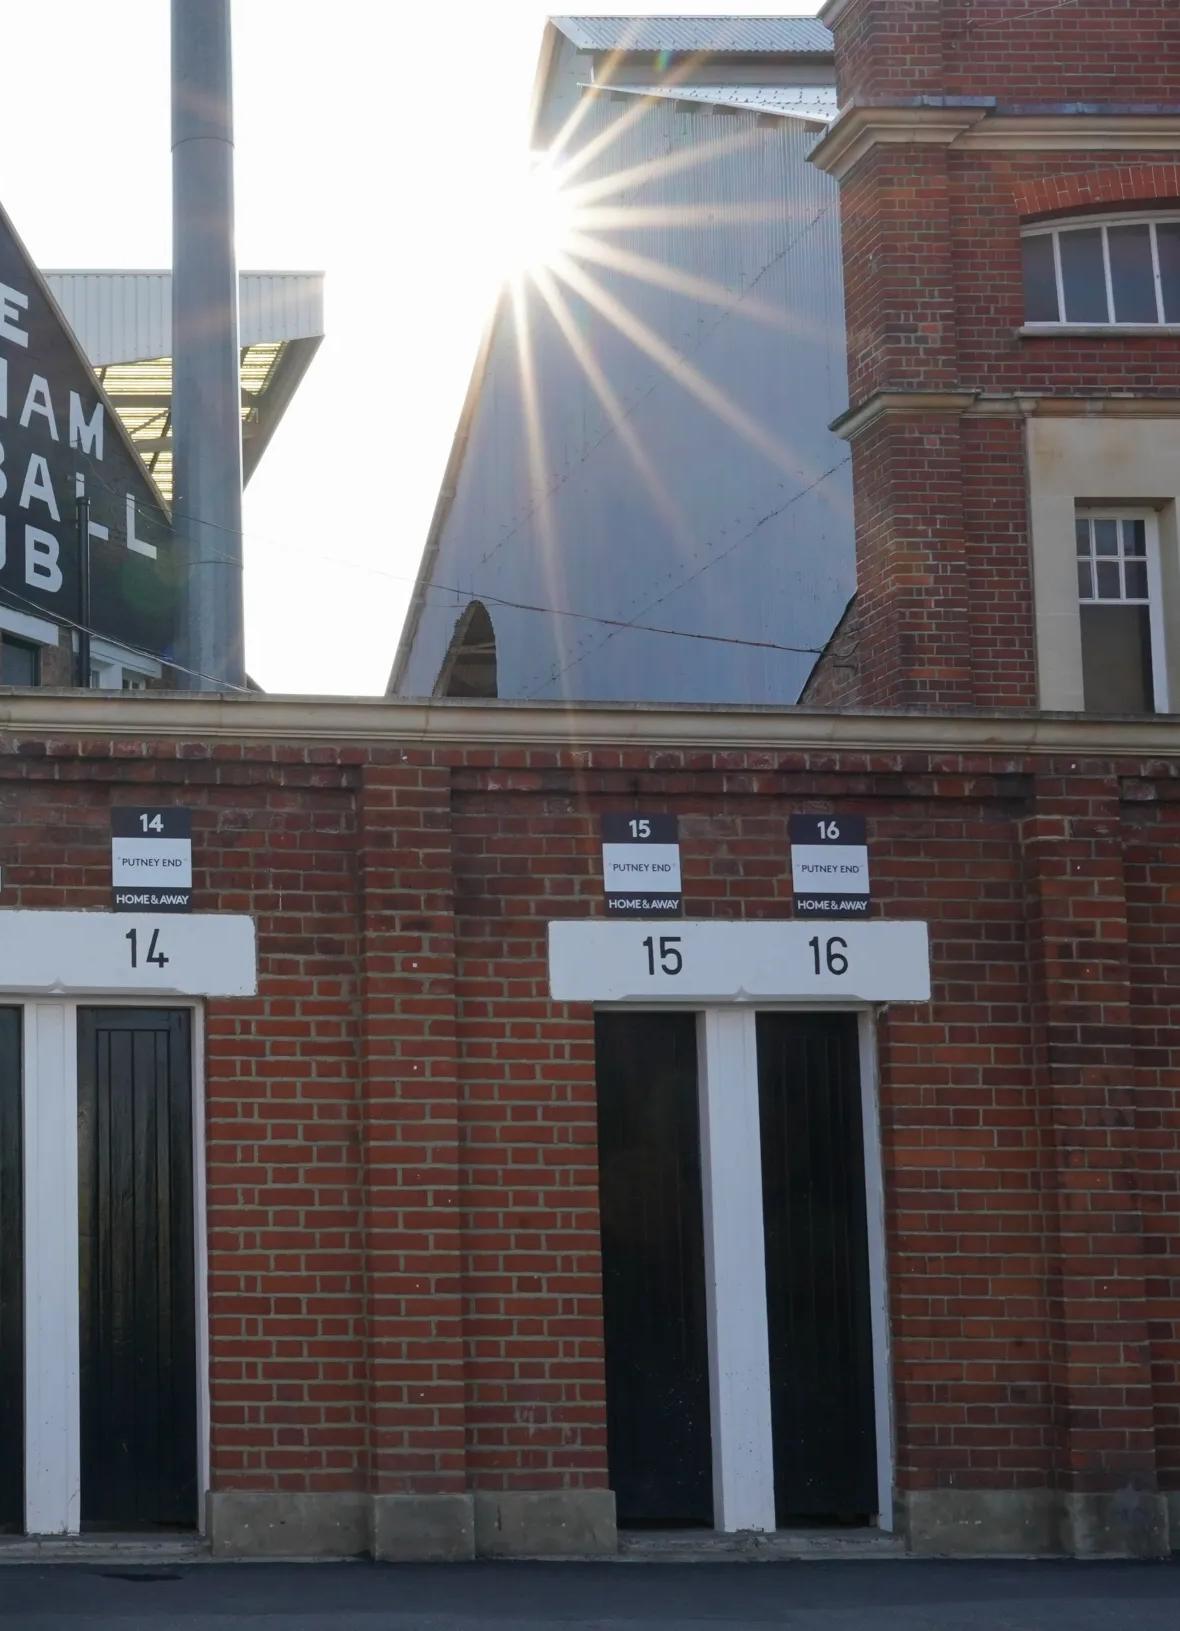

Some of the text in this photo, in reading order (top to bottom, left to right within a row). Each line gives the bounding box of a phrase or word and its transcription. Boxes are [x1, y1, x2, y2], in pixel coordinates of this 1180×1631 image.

[139, 813, 164, 833] 14
[628, 819, 651, 838] 15
[817, 820, 840, 839] 16
[122, 858, 182, 867] PUTNEY END
[612, 863, 671, 872] PUTNEY END
[801, 864, 860, 874] PUTNEY END
[125, 927, 169, 968] 14
[642, 936, 684, 976] 15
[808, 936, 849, 975] 16
